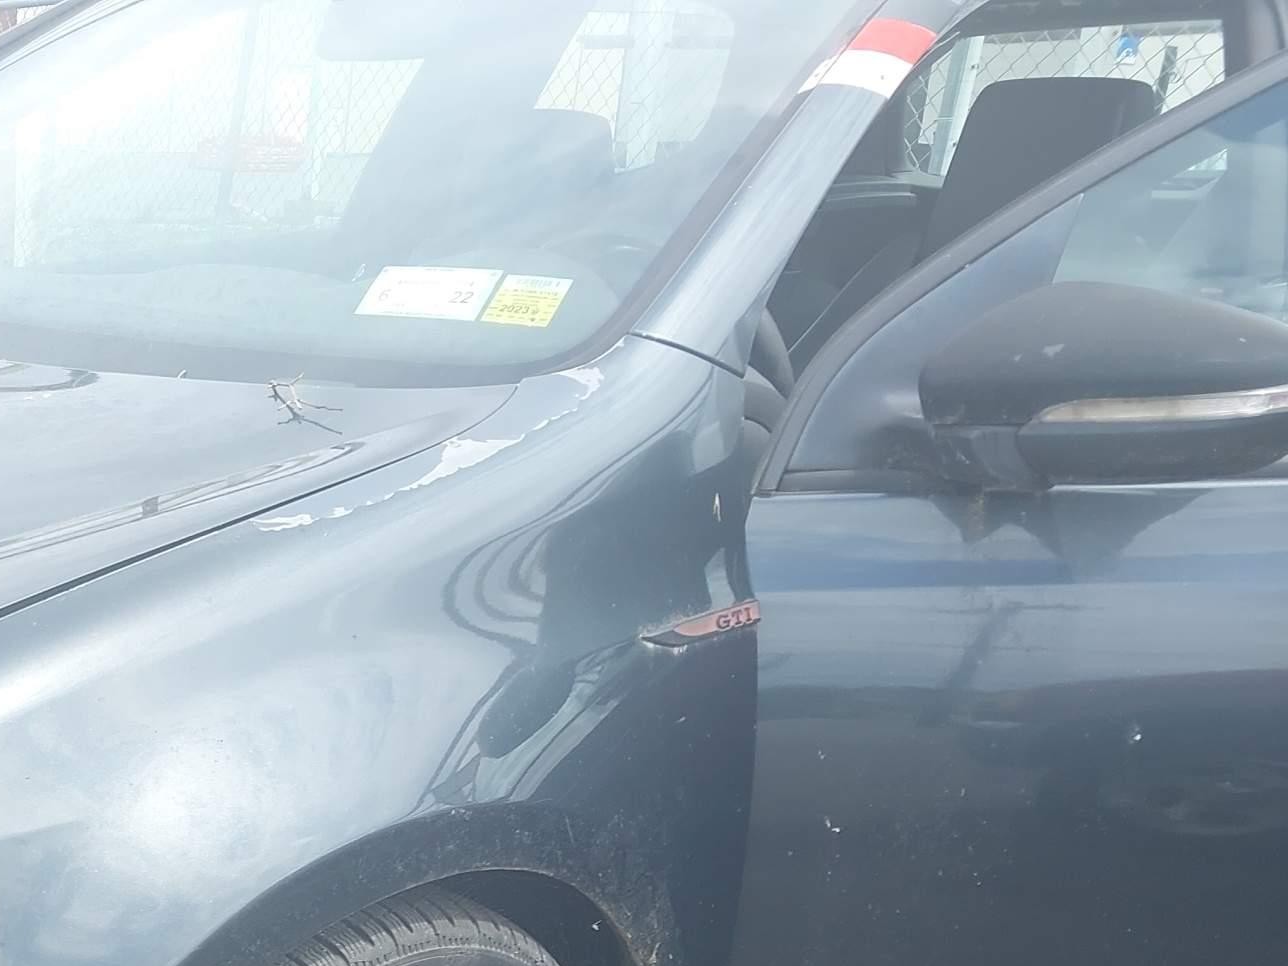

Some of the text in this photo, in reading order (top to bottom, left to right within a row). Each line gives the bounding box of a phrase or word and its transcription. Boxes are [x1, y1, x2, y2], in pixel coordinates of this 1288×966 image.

[447, 290, 475, 305] 22
[497, 303, 531, 315] 2023
[715, 607, 753, 630] GTI
